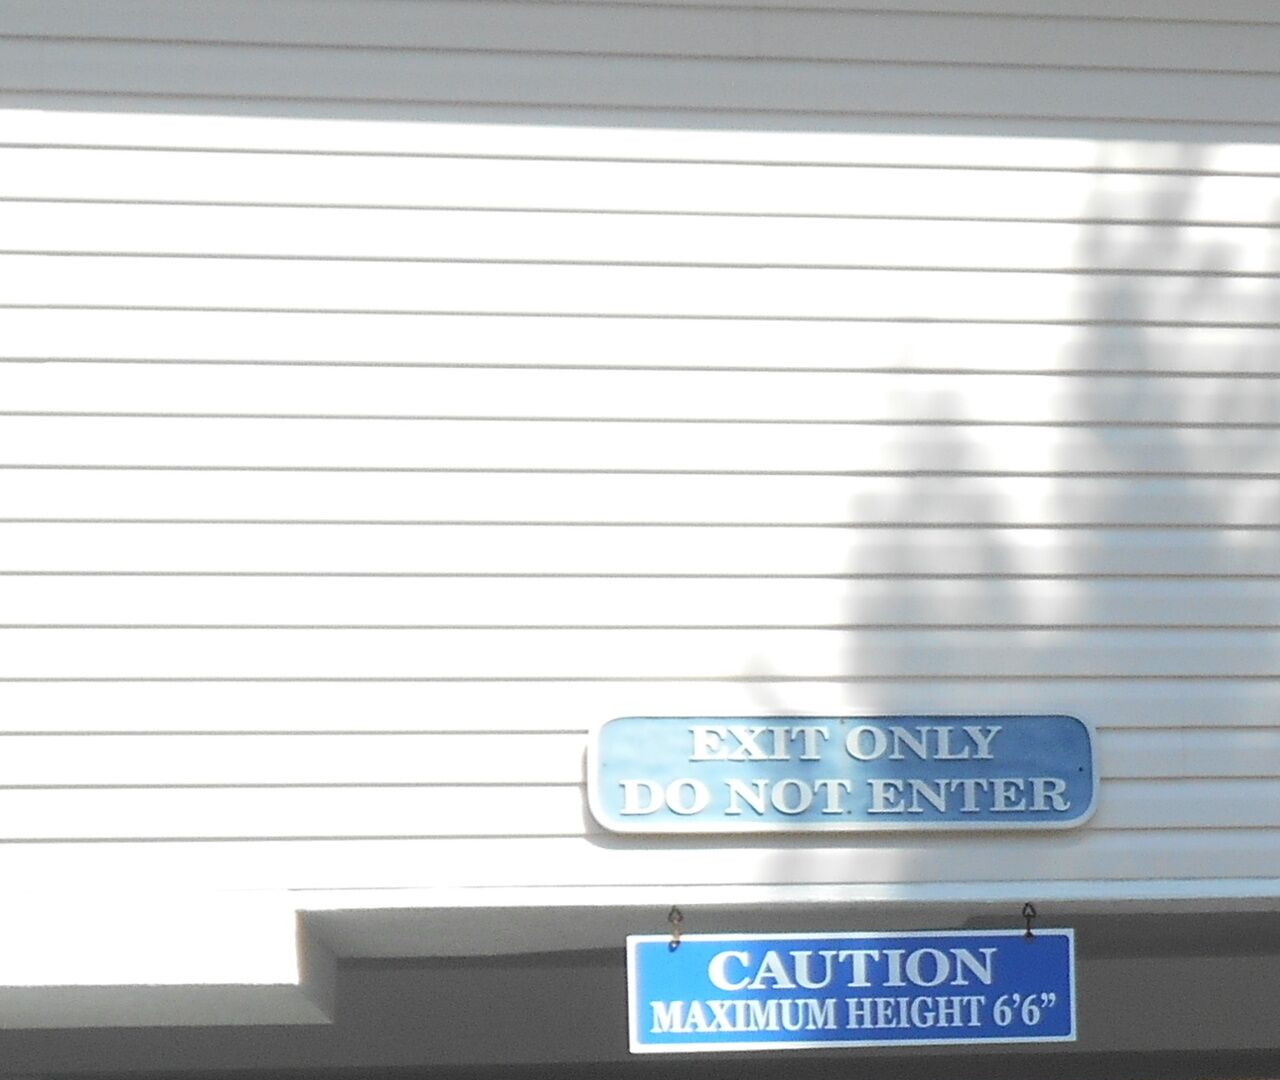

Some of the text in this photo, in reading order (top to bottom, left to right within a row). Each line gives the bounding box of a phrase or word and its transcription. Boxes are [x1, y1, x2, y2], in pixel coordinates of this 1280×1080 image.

[688, 725, 1002, 761] EXIT ONLY
[619, 777, 1071, 816] DO NOT ENTER
[708, 947, 998, 992] CAUTION
[649, 997, 838, 1035] MAXIMUM
[845, 995, 986, 1030] HEIGHT
